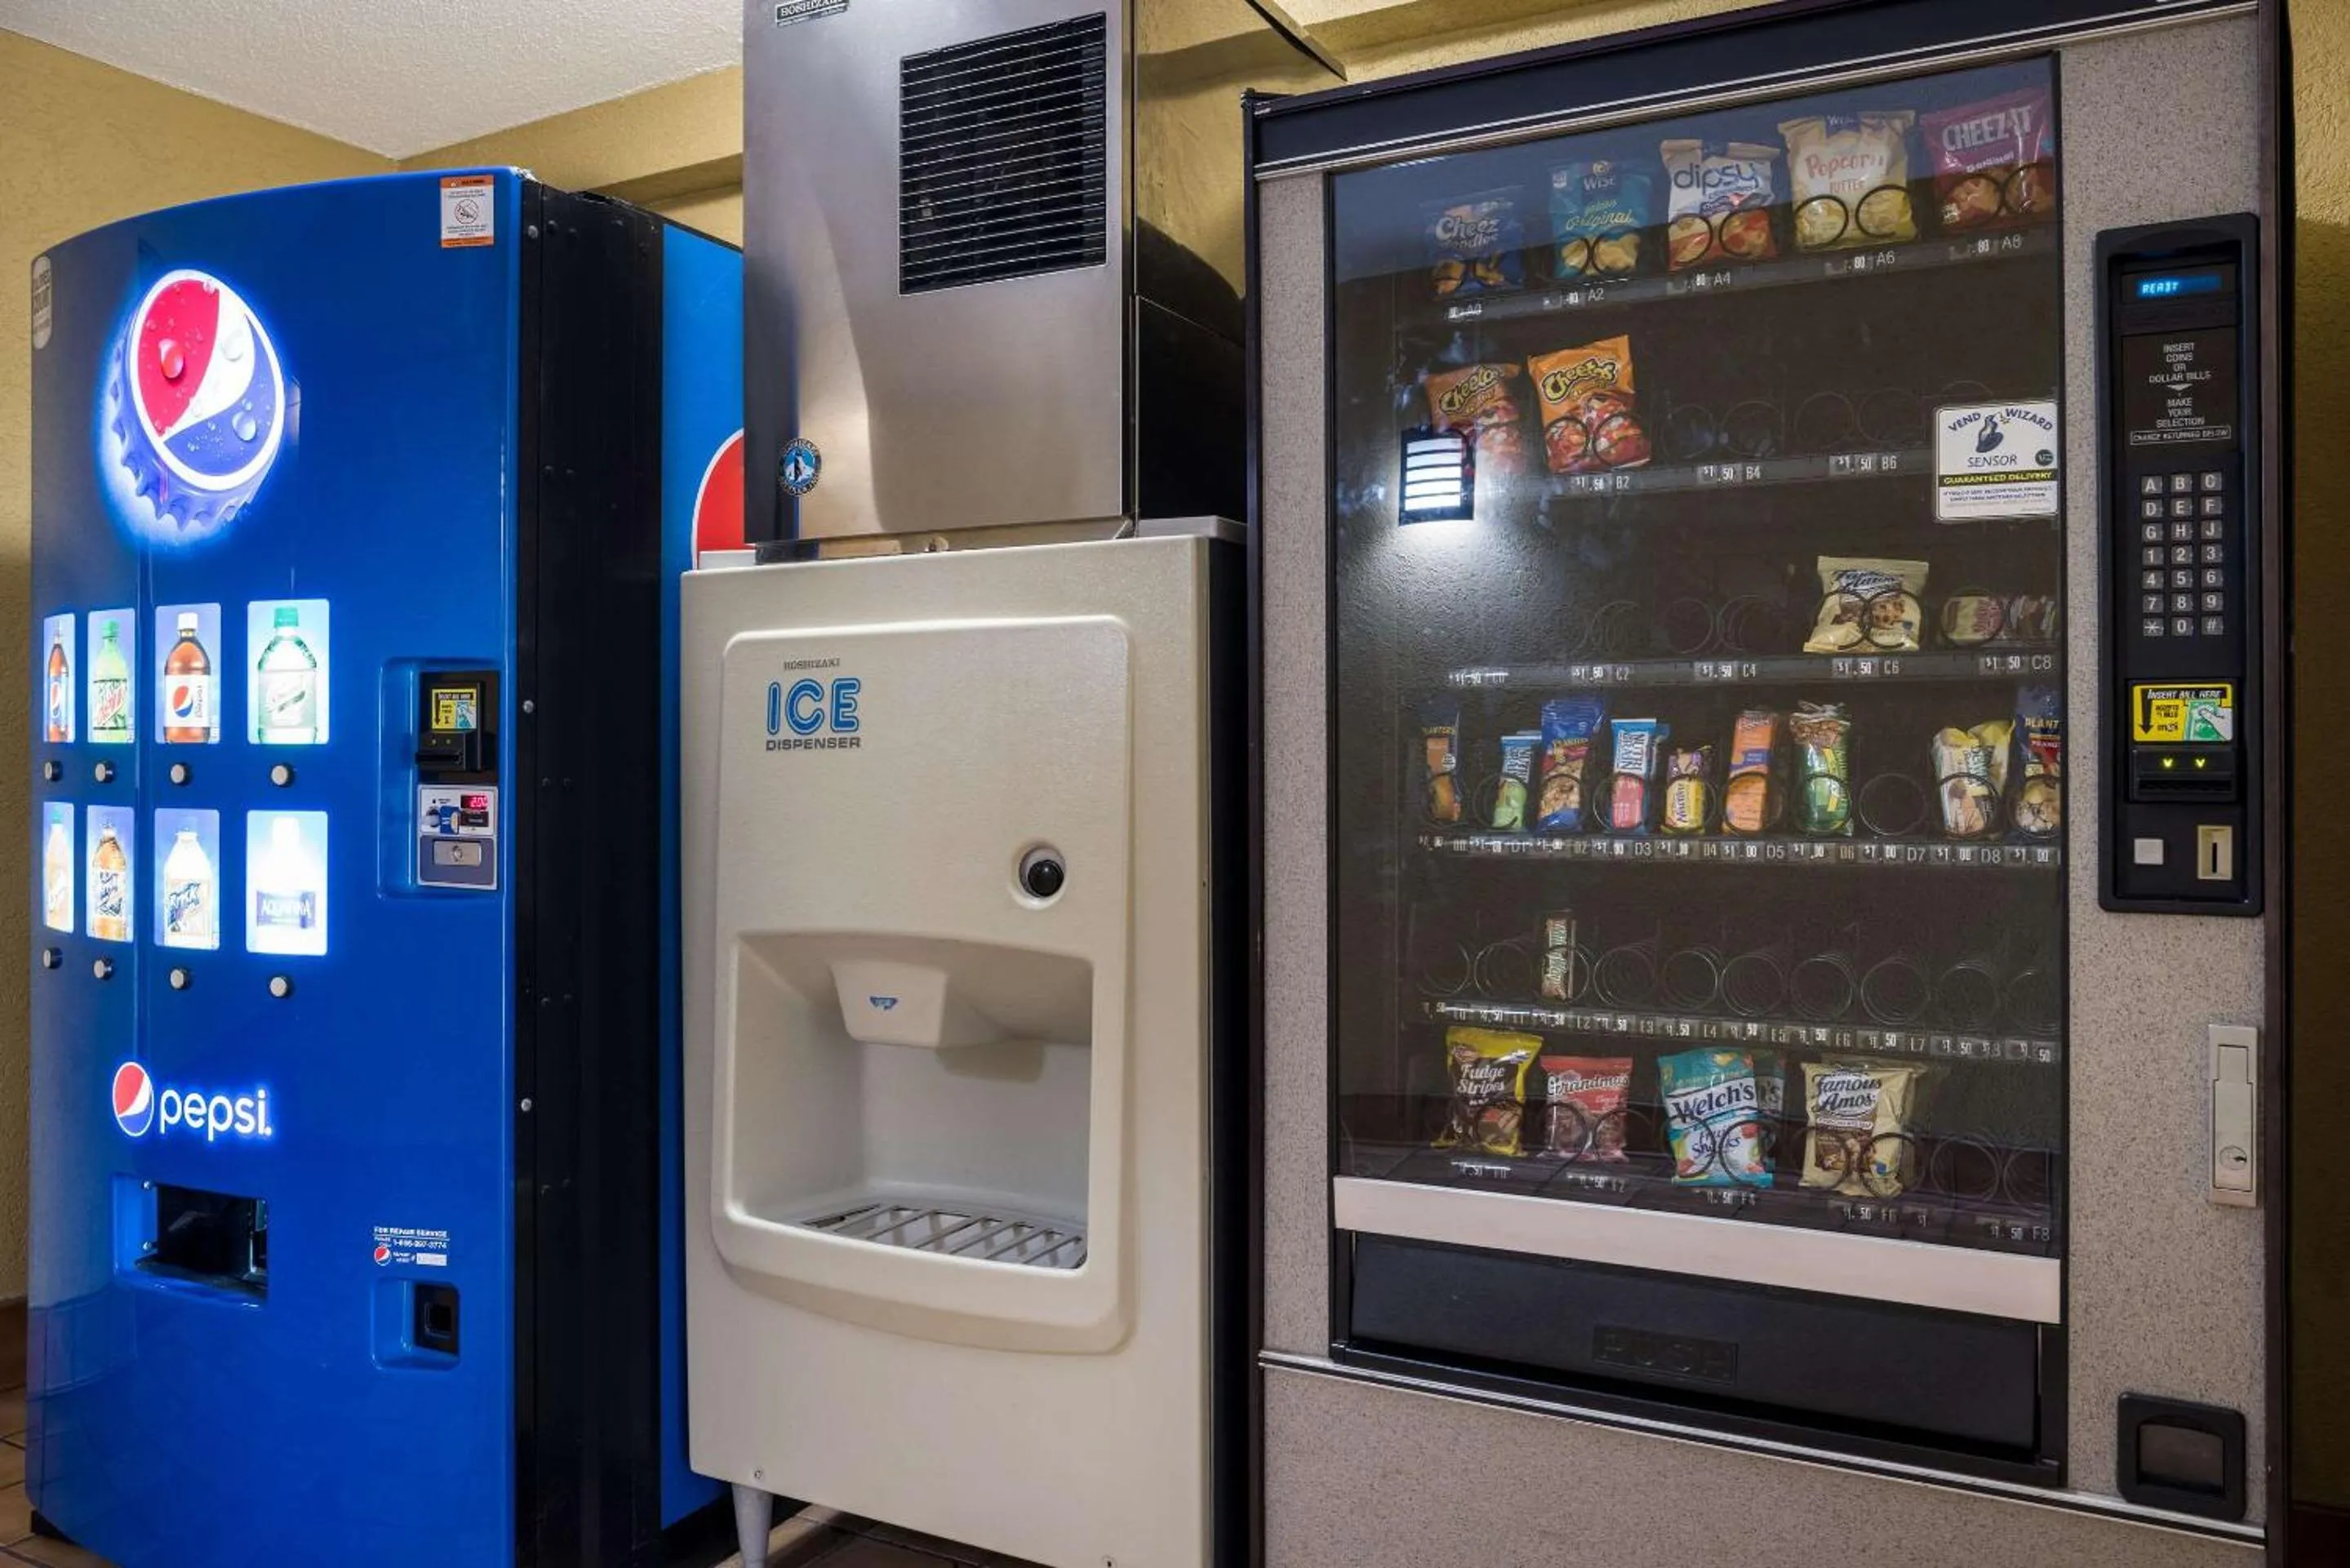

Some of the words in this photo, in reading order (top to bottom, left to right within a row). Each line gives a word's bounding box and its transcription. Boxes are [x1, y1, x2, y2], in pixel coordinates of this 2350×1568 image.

[1674, 162, 1759, 196] dipsy
[1436, 216, 1502, 241] Cheez
[2001, 236, 2022, 250] A8
[1877, 251, 1895, 266] A6
[1713, 273, 1731, 286] A4
[1588, 289, 1605, 302] A2
[2163, 343, 2194, 353] INSERT
[2166, 353, 2192, 362] COINS
[2174, 363, 2186, 372] OR
[2149, 372, 2183, 383] DOLLAR
[2186, 371, 2211, 381] BILLS
[2167, 398, 2192, 407] MAKE
[1948, 413, 1981, 432] VEND
[2005, 408, 2053, 431] WIZARD
[2168, 408, 2192, 417] YOUR
[2156, 417, 2205, 428] SELECTION
[1967, 455, 2018, 468] SENSOR
[1944, 475, 2006, 486] GUARANTEED
[2145, 478, 2156, 491] A
[2175, 478, 2185, 490] B
[2205, 474, 2215, 487] C
[2146, 502, 2157, 517] D
[2175, 500, 2185, 514] E
[2206, 500, 2215, 513] F
[2145, 526, 2157, 540] G
[2175, 525, 2186, 537] H
[2206, 522, 2215, 535] J
[2148, 549, 2154, 563] 1
[2176, 548, 2185, 561] 2
[2206, 546, 2215, 560] 3
[2148, 572, 2156, 586] 4
[2177, 571, 2186, 584] 5
[2206, 570, 2215, 584] 6
[2148, 597, 2157, 610] 7
[2177, 595, 2186, 609] 8
[2206, 594, 2216, 607] 9
[2177, 619, 2186, 633] 0
[784, 658, 840, 670] HOSHIZAKI
[2032, 655, 2051, 670] C8
[2148, 689, 2177, 700] INSERT
[767, 677, 861, 735] ICE
[766, 737, 861, 751] DISPENSER
[1635, 842, 1652, 856] D3
[1766, 844, 1785, 860] D5
[1907, 846, 1926, 862] D7
[1981, 847, 2001, 864] D8
[1460, 1064, 1505, 1082] Fudge
[1457, 1079, 1505, 1096] Stripes
[1817, 1076, 1882, 1095] Famous
[1671, 1082, 1756, 1124] Welch's
[1817, 1093, 1872, 1113] Amos
[2032, 1226, 2050, 1242] F8
